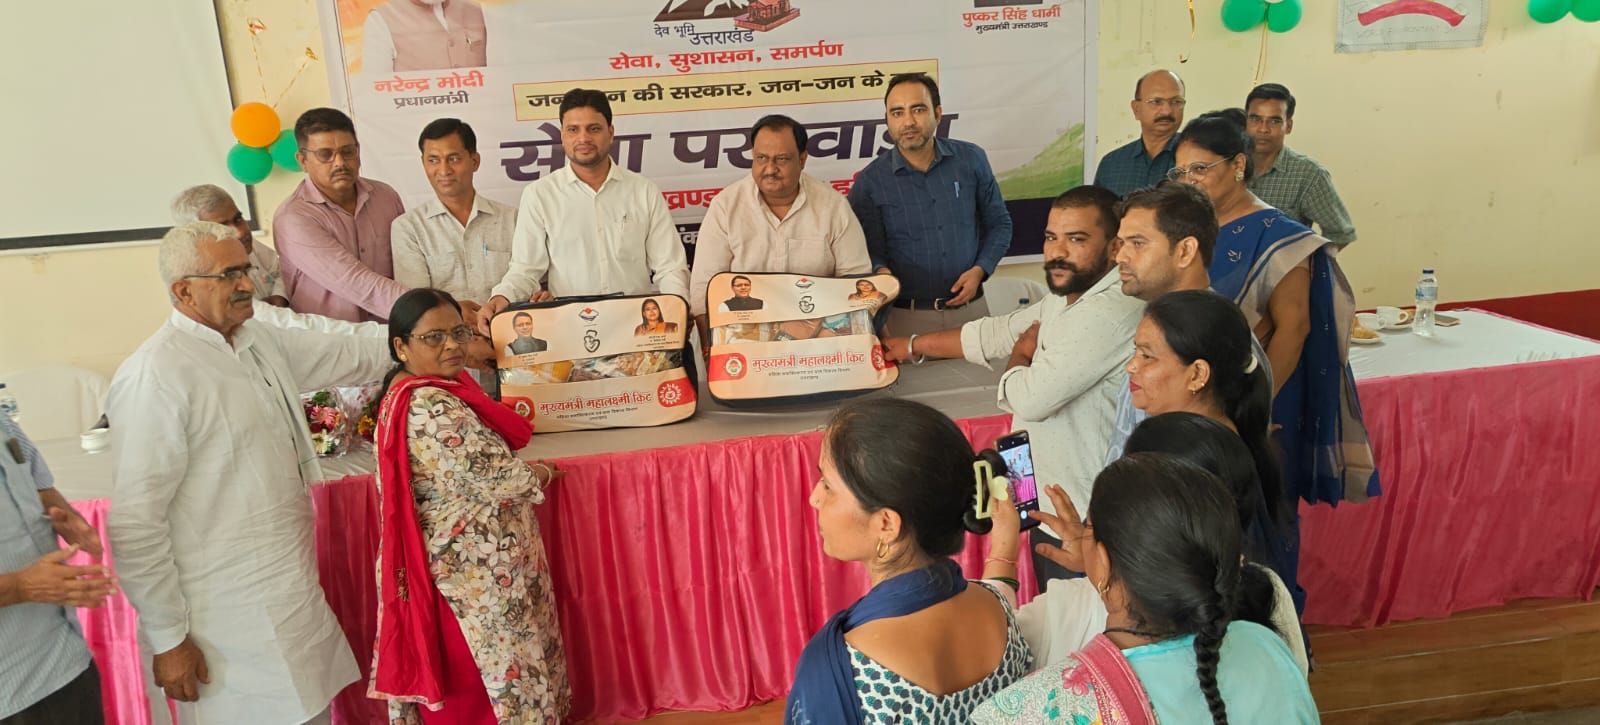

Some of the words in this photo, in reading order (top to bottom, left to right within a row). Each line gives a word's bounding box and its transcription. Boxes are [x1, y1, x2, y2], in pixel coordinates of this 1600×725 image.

[962, 11, 999, 27] पुष्कर
[1002, 7, 1028, 20] सिंह
[1031, 4, 1062, 18] धामी
[654, 24, 669, 37] देव
[674, 22, 695, 38] भूमि
[688, 28, 755, 46] उत्तराखंड
[975, 21, 1010, 34] मुख्यमंत्री
[609, 52, 661, 70] सेवा,
[669, 49, 762, 73] सुशासन,
[769, 40, 843, 61] समर्पण
[373, 73, 430, 93] नरेन्द्र
[436, 70, 485, 90] मोदी
[633, 83, 663, 102] की
[669, 81, 752, 100] सरकार,
[759, 75, 856, 94] जन-जन
[861, 70, 885, 87] के
[393, 90, 469, 109] प्रधानमंत्री
[752, 355, 796, 373] मुख्यमंत्री
[799, 351, 843, 367] महालक्ष्मी
[846, 351, 865, 363] किट
[540, 397, 583, 416] मुख्यमंत्री
[586, 392, 631, 409] महालक्ष्मी
[632, 391, 652, 405] किट
